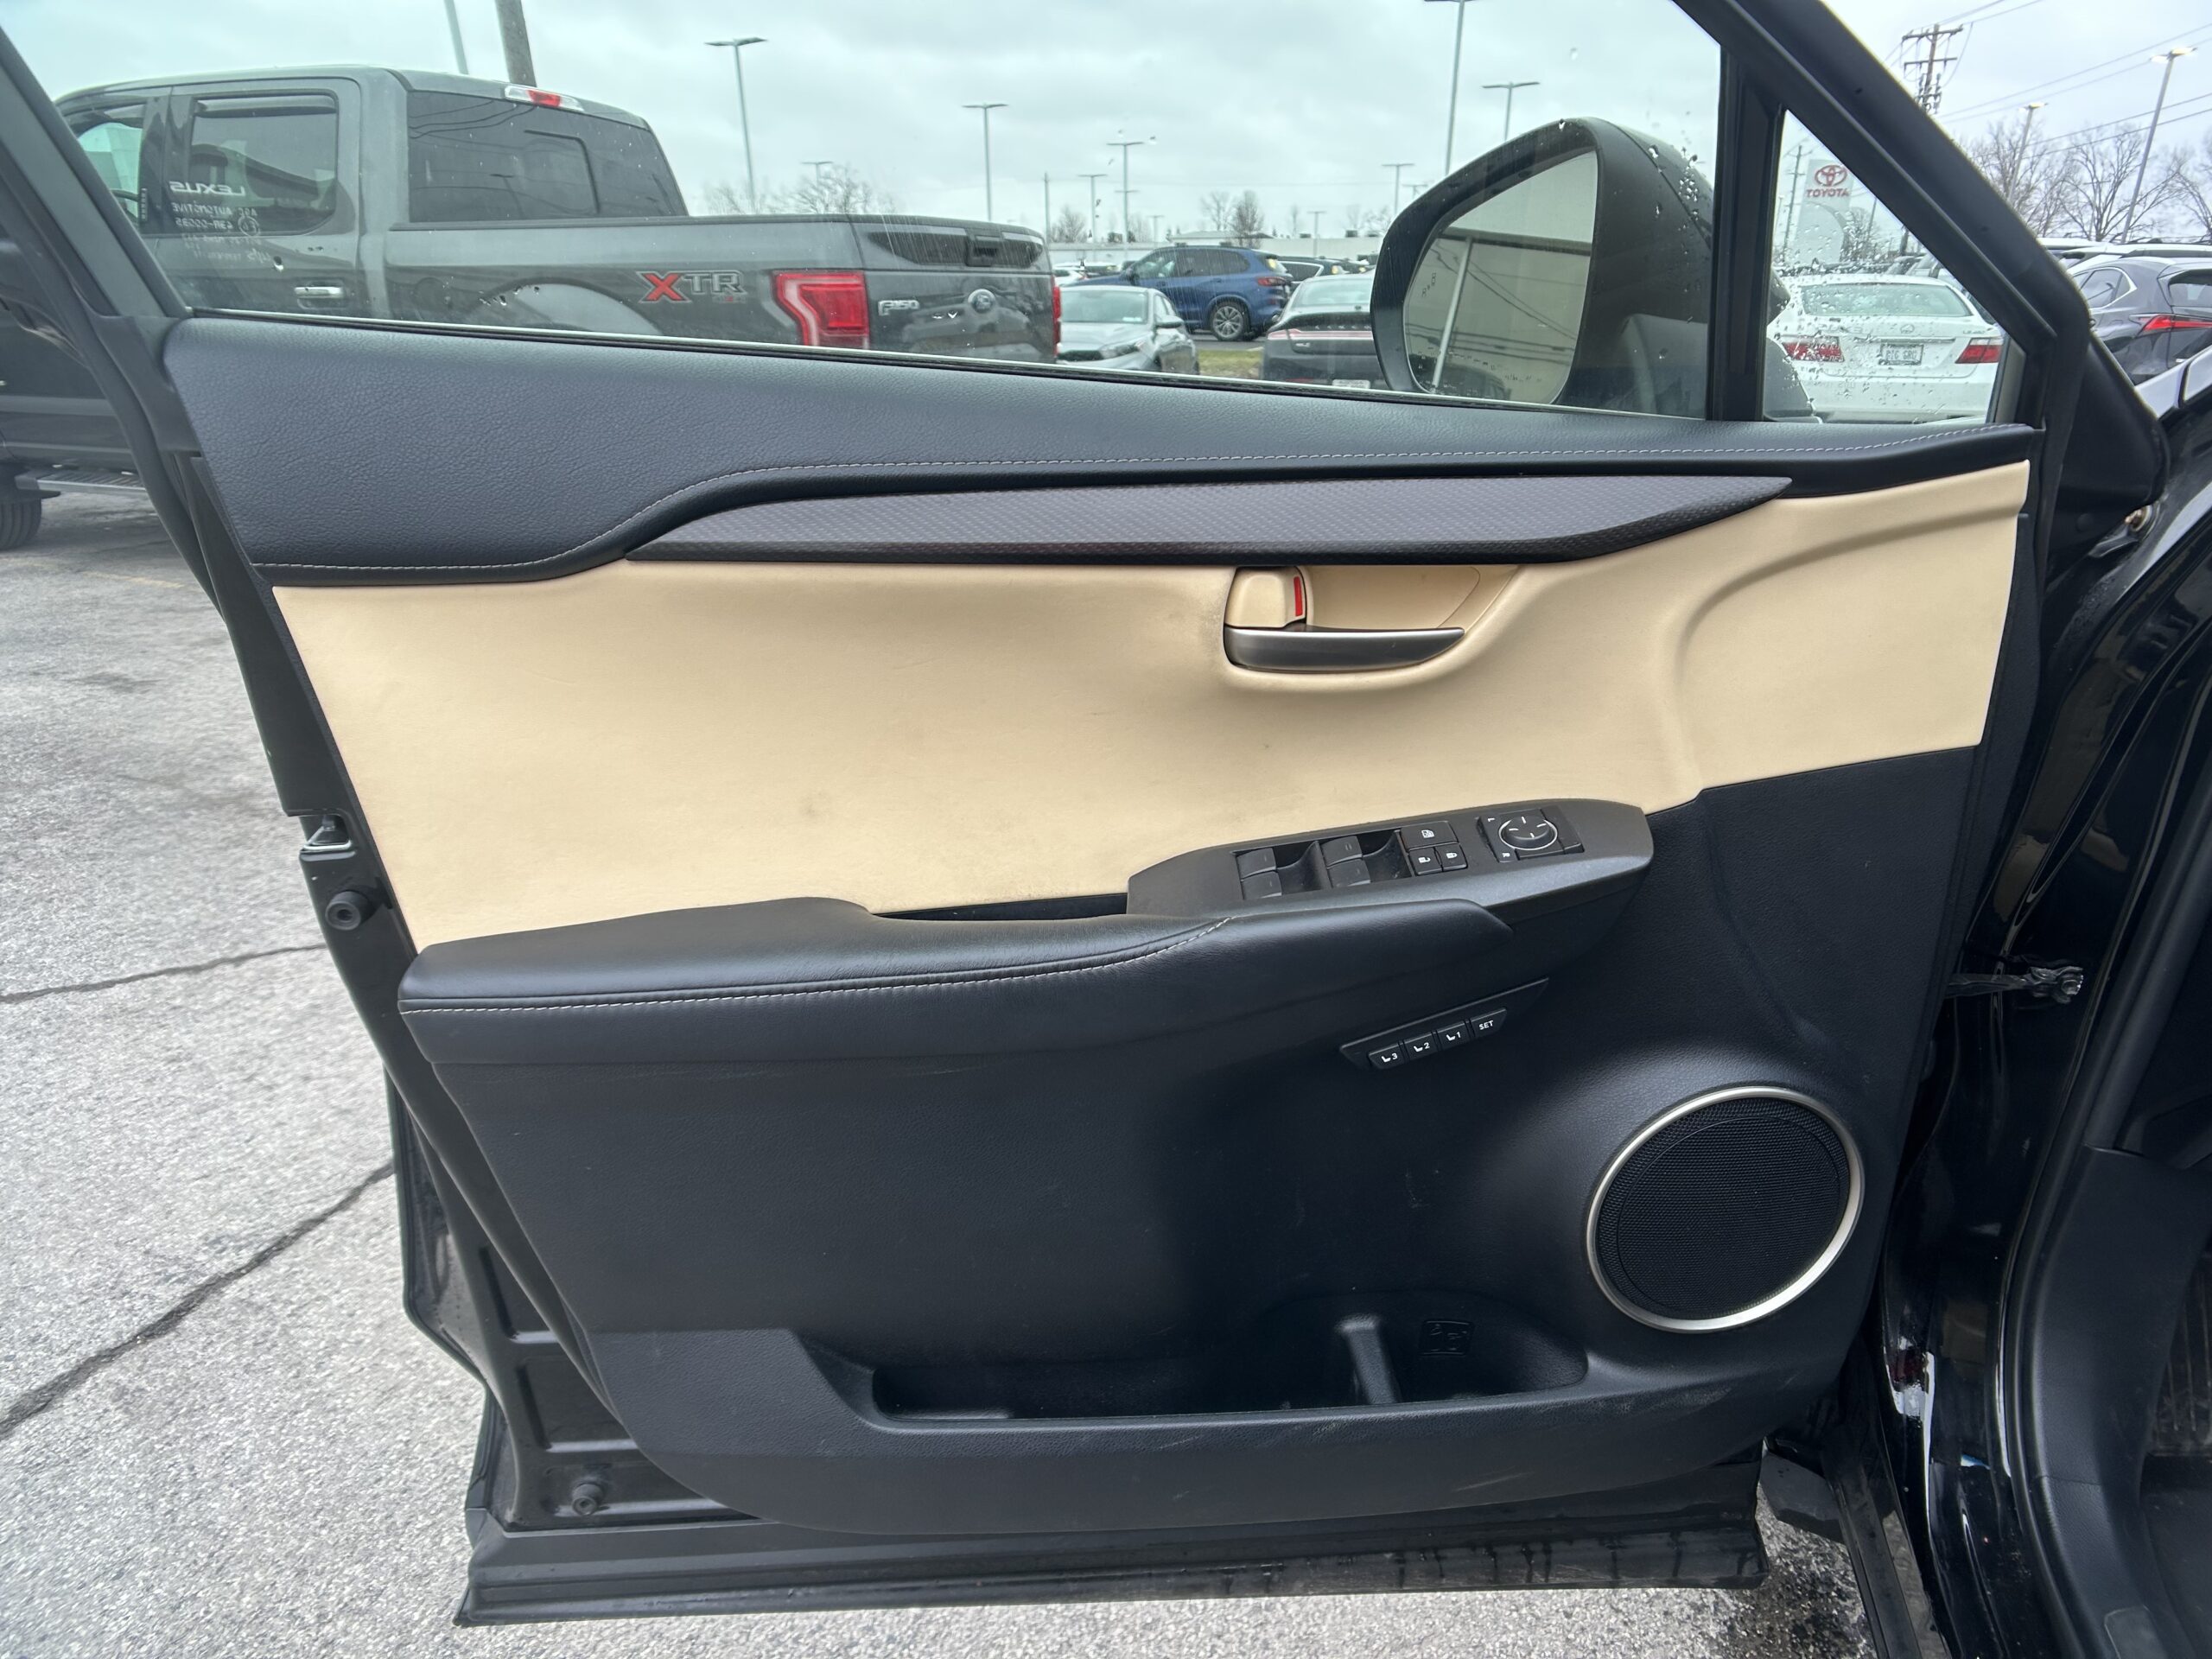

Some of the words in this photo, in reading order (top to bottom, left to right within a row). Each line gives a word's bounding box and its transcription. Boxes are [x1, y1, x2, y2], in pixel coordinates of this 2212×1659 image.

[1807, 188, 1849, 198] TOYOTA
[637, 270, 747, 302] XTR
[1478, 1020, 1494, 1031] SET
